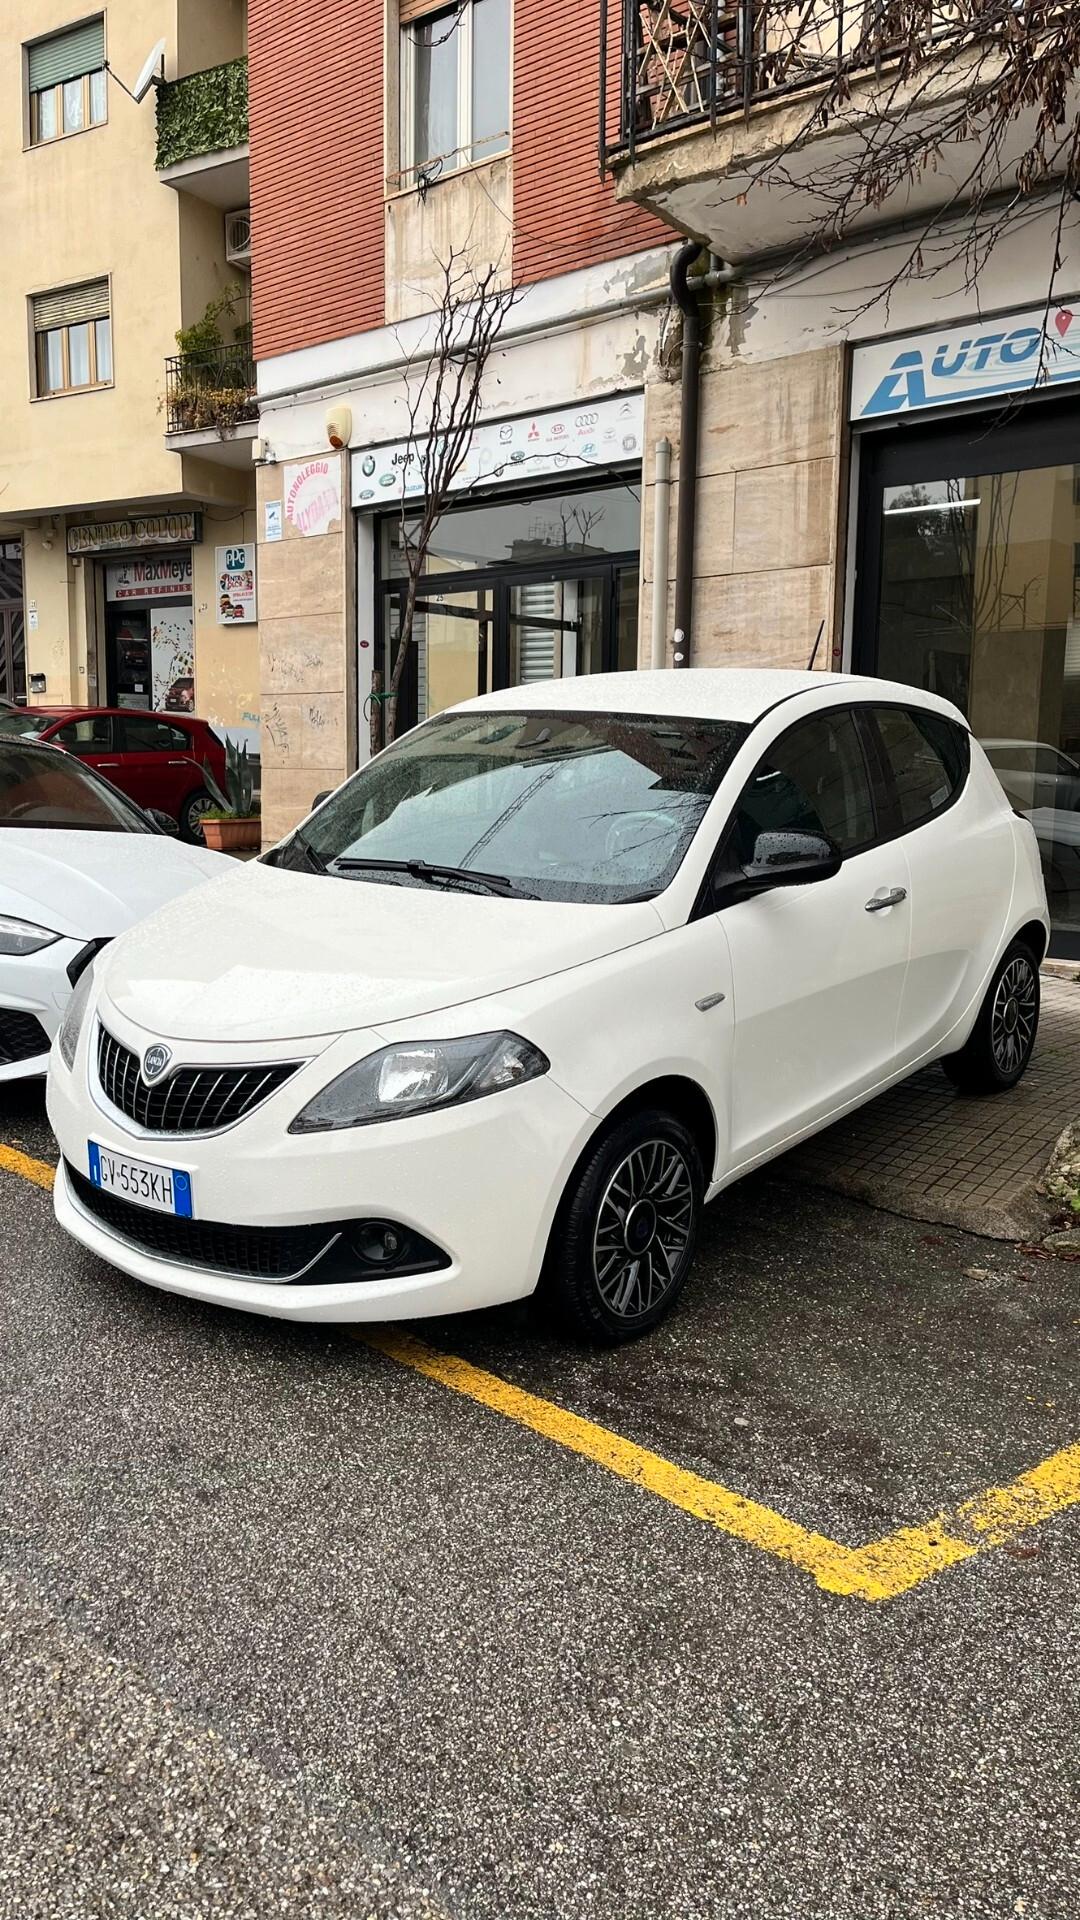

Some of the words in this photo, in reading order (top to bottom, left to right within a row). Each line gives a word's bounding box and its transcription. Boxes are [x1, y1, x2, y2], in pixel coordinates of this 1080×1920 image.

[860, 327, 1042, 416] AUTO
[391, 452, 415, 466] Jeep
[286, 462, 329, 521] AUTONOLEGGIO
[134, 514, 194, 541] COLOR
[227, 549, 245, 567] PPG
[117, 589, 137, 597] CAR
[143, 584, 193, 594] REFINIS
